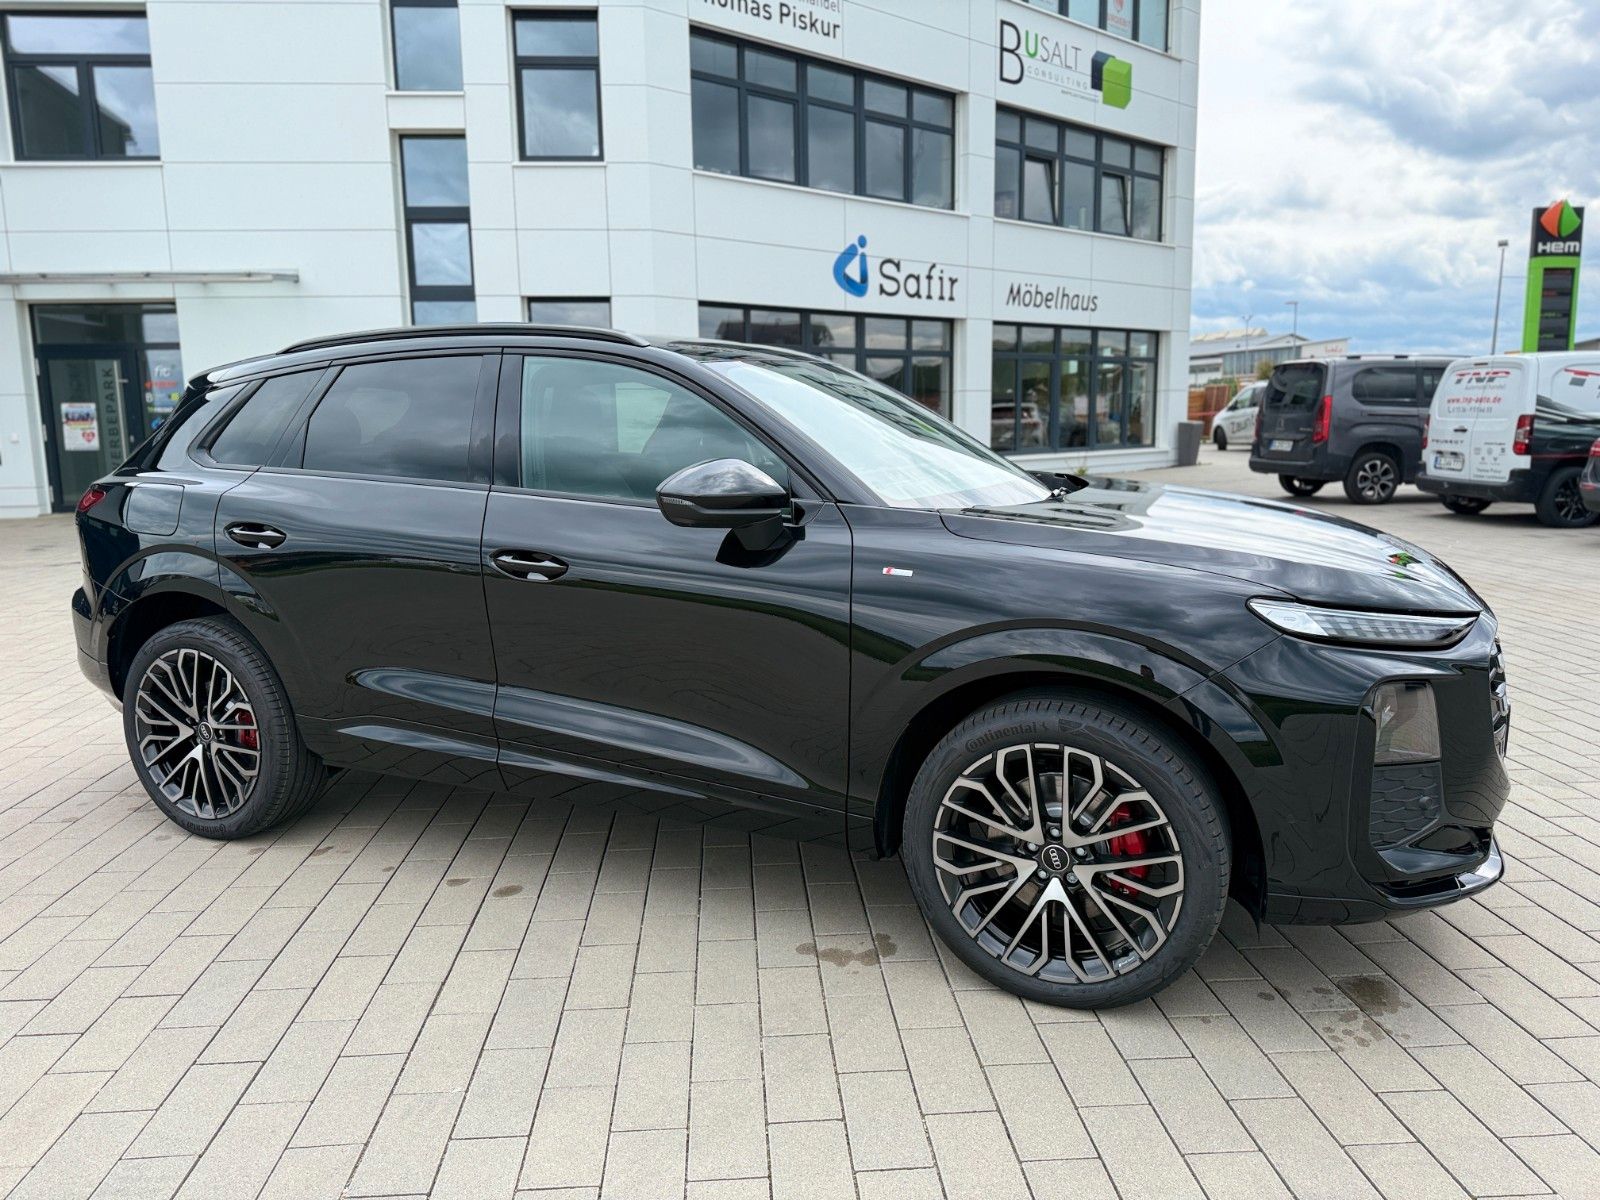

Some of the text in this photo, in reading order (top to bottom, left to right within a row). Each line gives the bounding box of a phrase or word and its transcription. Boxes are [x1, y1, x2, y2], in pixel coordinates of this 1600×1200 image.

[703, 0, 841, 39] omas Piskur
[806, 0, 841, 13] andel
[999, 19, 1082, 85] BUSALT
[1026, 65, 1089, 91] CONSULTING
[878, 258, 959, 302] Safir
[1005, 282, 1099, 312] Möbelhaus
[964, 721, 1037, 753] Continental
